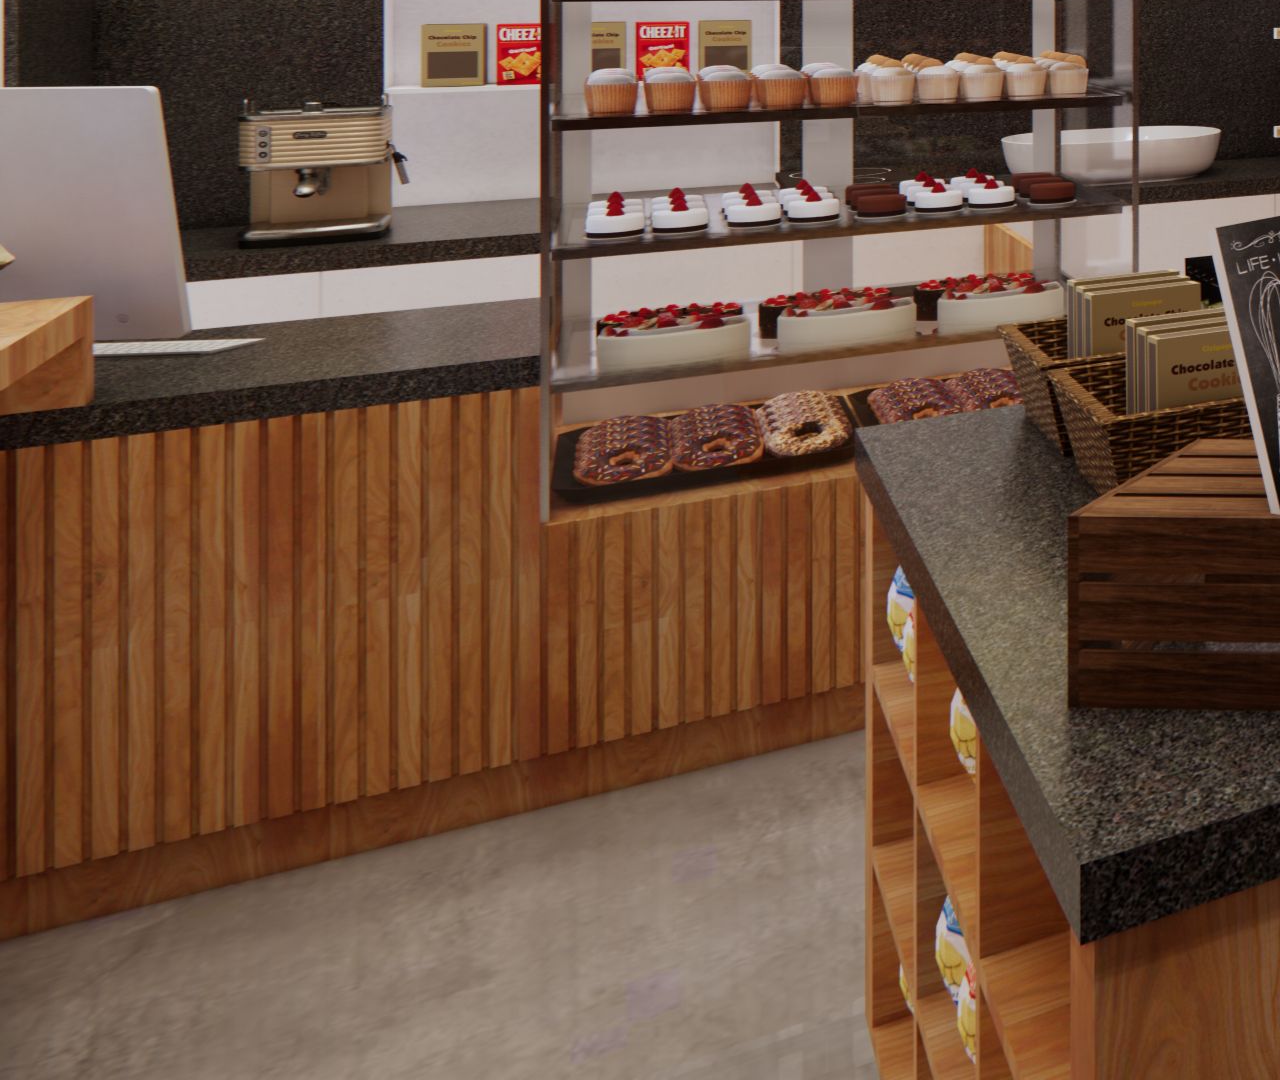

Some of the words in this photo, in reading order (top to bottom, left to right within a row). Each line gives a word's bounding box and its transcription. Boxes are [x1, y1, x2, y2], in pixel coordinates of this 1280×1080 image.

[498, 28, 541, 41] CHEEZ-I
[1236, 255, 1271, 275] LIFE
[1171, 358, 1235, 375] Chocolate
[1188, 370, 1241, 391] Cooki
